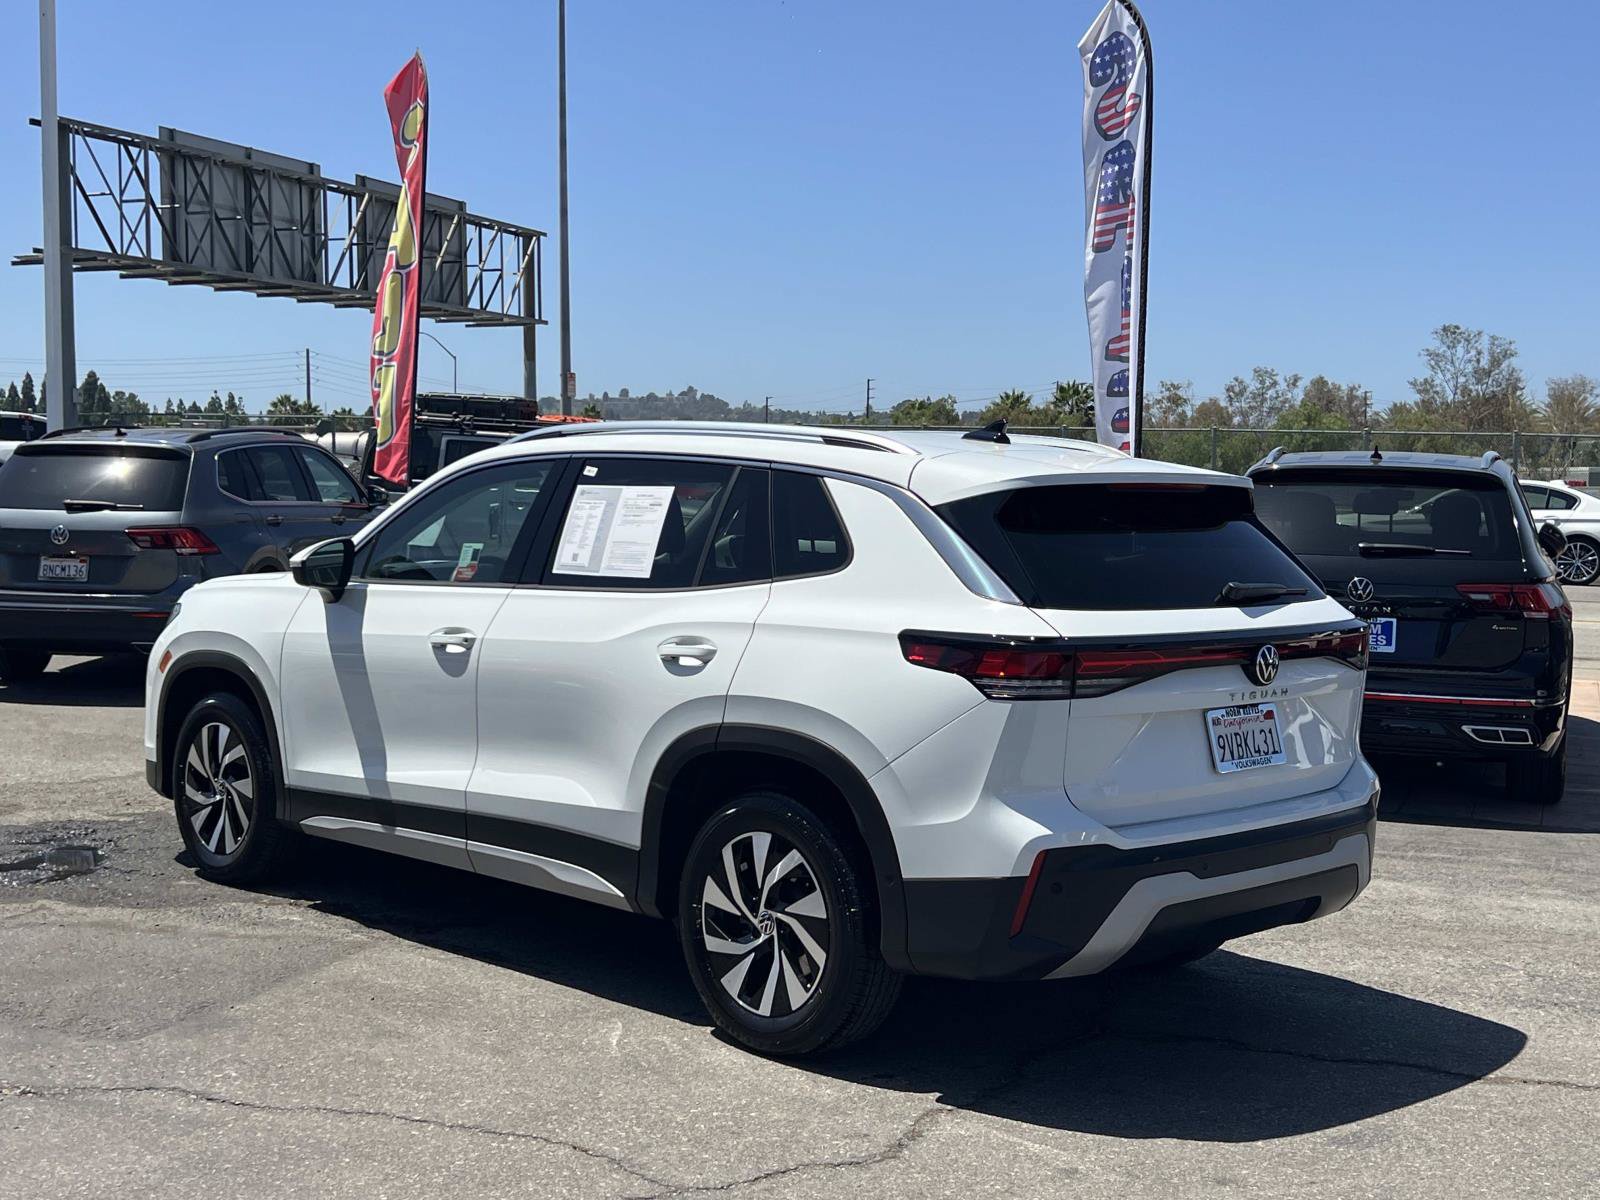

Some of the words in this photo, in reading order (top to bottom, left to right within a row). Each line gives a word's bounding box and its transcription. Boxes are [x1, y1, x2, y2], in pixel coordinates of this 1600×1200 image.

[43, 563, 84, 577] 8NCM136
[1348, 605, 1391, 613] GUAN
[1228, 687, 1289, 701] TIGUAN
[1217, 727, 1280, 763] 9VBK431
